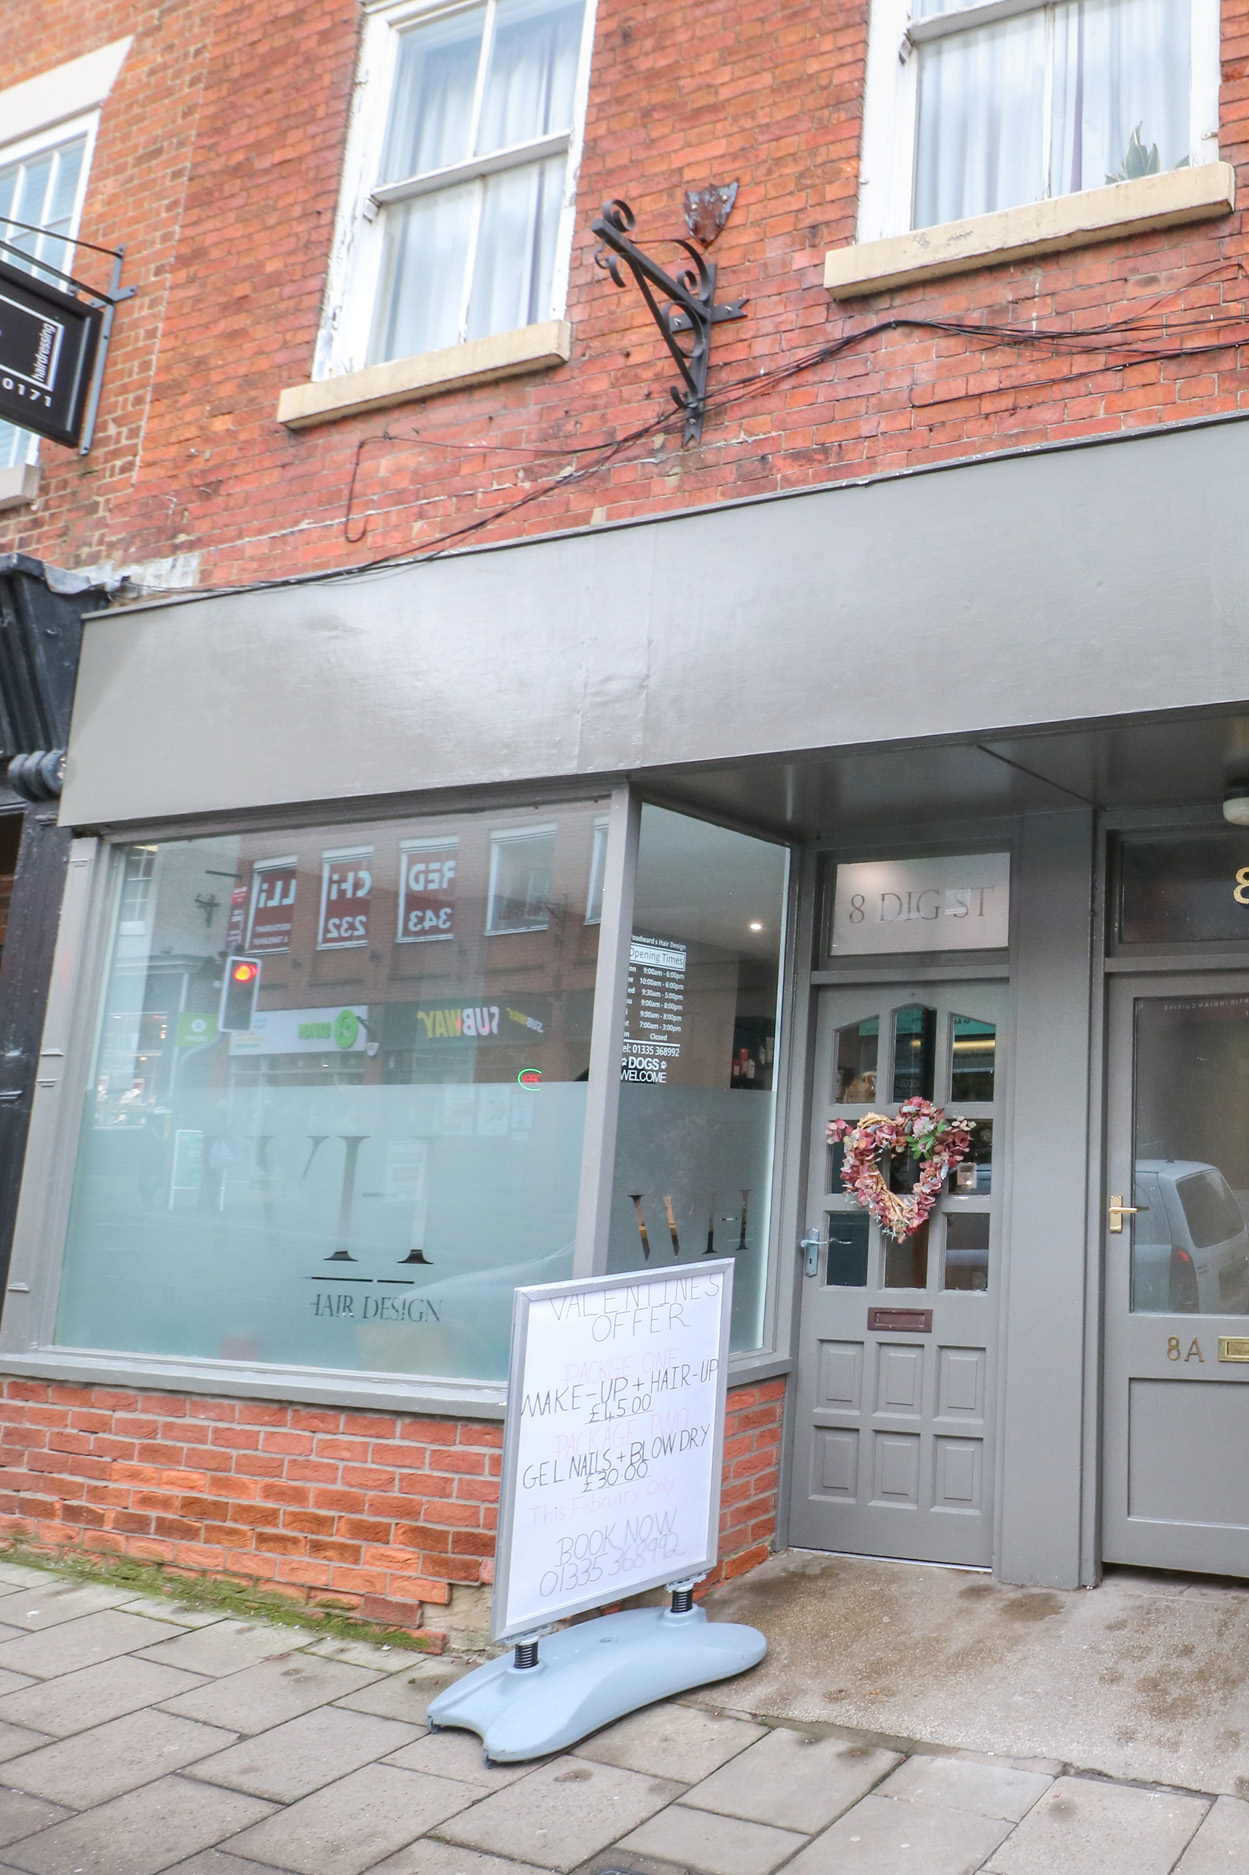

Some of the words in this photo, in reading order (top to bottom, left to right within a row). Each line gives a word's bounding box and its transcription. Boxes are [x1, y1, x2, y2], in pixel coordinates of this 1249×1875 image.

[31, 322, 57, 382] hairdressing
[0, 377, 52, 407] 0171
[849, 893, 866, 924] 8
[879, 889, 941, 921] DIG
[630, 947, 661, 963] Opening
[662, 953, 684, 965] Times
[632, 1044, 654, 1055] 01335
[655, 1046, 680, 1057] 368992
[650, 1032, 668, 1042] Closed
[620, 1069, 667, 1083] WELCOME
[628, 1056, 660, 1070] DOGS
[310, 1293, 354, 1318] HAIR
[362, 1295, 443, 1323] DESIGN
[592, 1302, 690, 1342] OFFER
[641, 1348, 680, 1371] ONE
[1166, 1335, 1205, 1362] 8A
[520, 1376, 629, 1418] MAKE-UP
[651, 1359, 719, 1394] HAIR-UP
[648, 1408, 690, 1435] TWO
[522, 1460, 565, 1489] GEL
[568, 1448, 612, 1480] NAILS
[528, 1505, 566, 1527] This
[571, 1488, 641, 1517] February
[554, 1522, 619, 1567] BOOK
[624, 1507, 678, 1546] NOW
[539, 1552, 609, 1597] 01335
